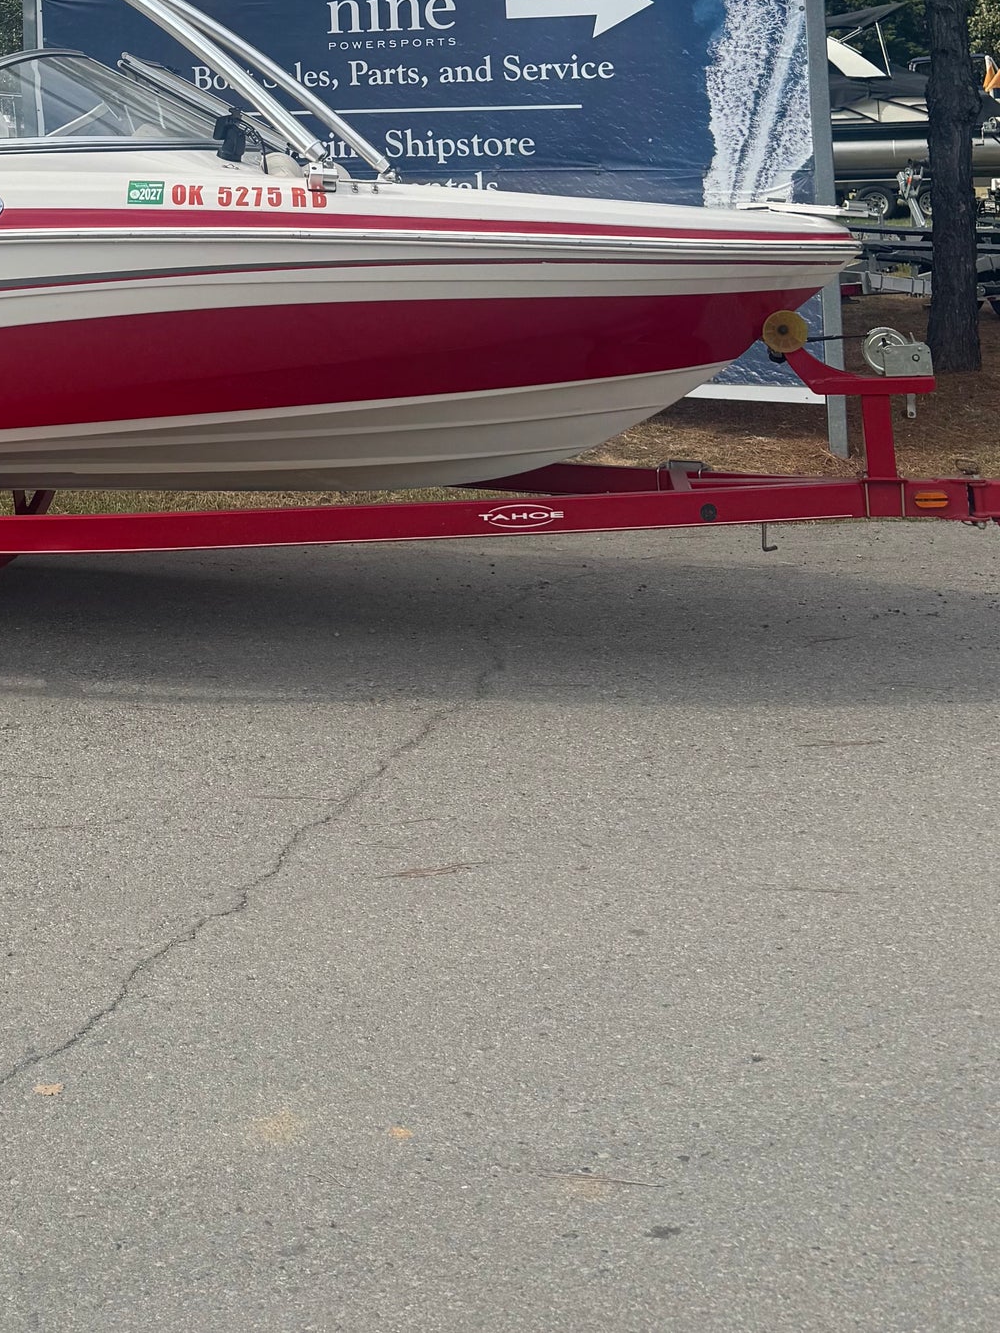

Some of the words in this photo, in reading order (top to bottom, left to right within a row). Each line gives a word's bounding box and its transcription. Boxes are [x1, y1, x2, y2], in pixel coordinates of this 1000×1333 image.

[328, 37, 457, 51] POWERSPORTS
[347, 60, 429, 88] Parts,
[439, 54, 494, 84] and
[503, 53, 615, 82] Service
[384, 128, 536, 164] Shipstore
[139, 188, 163, 201] 2027
[171, 184, 204, 206] OK
[217, 186, 283, 208] 5275
[478, 510, 565, 521] TAHOE
